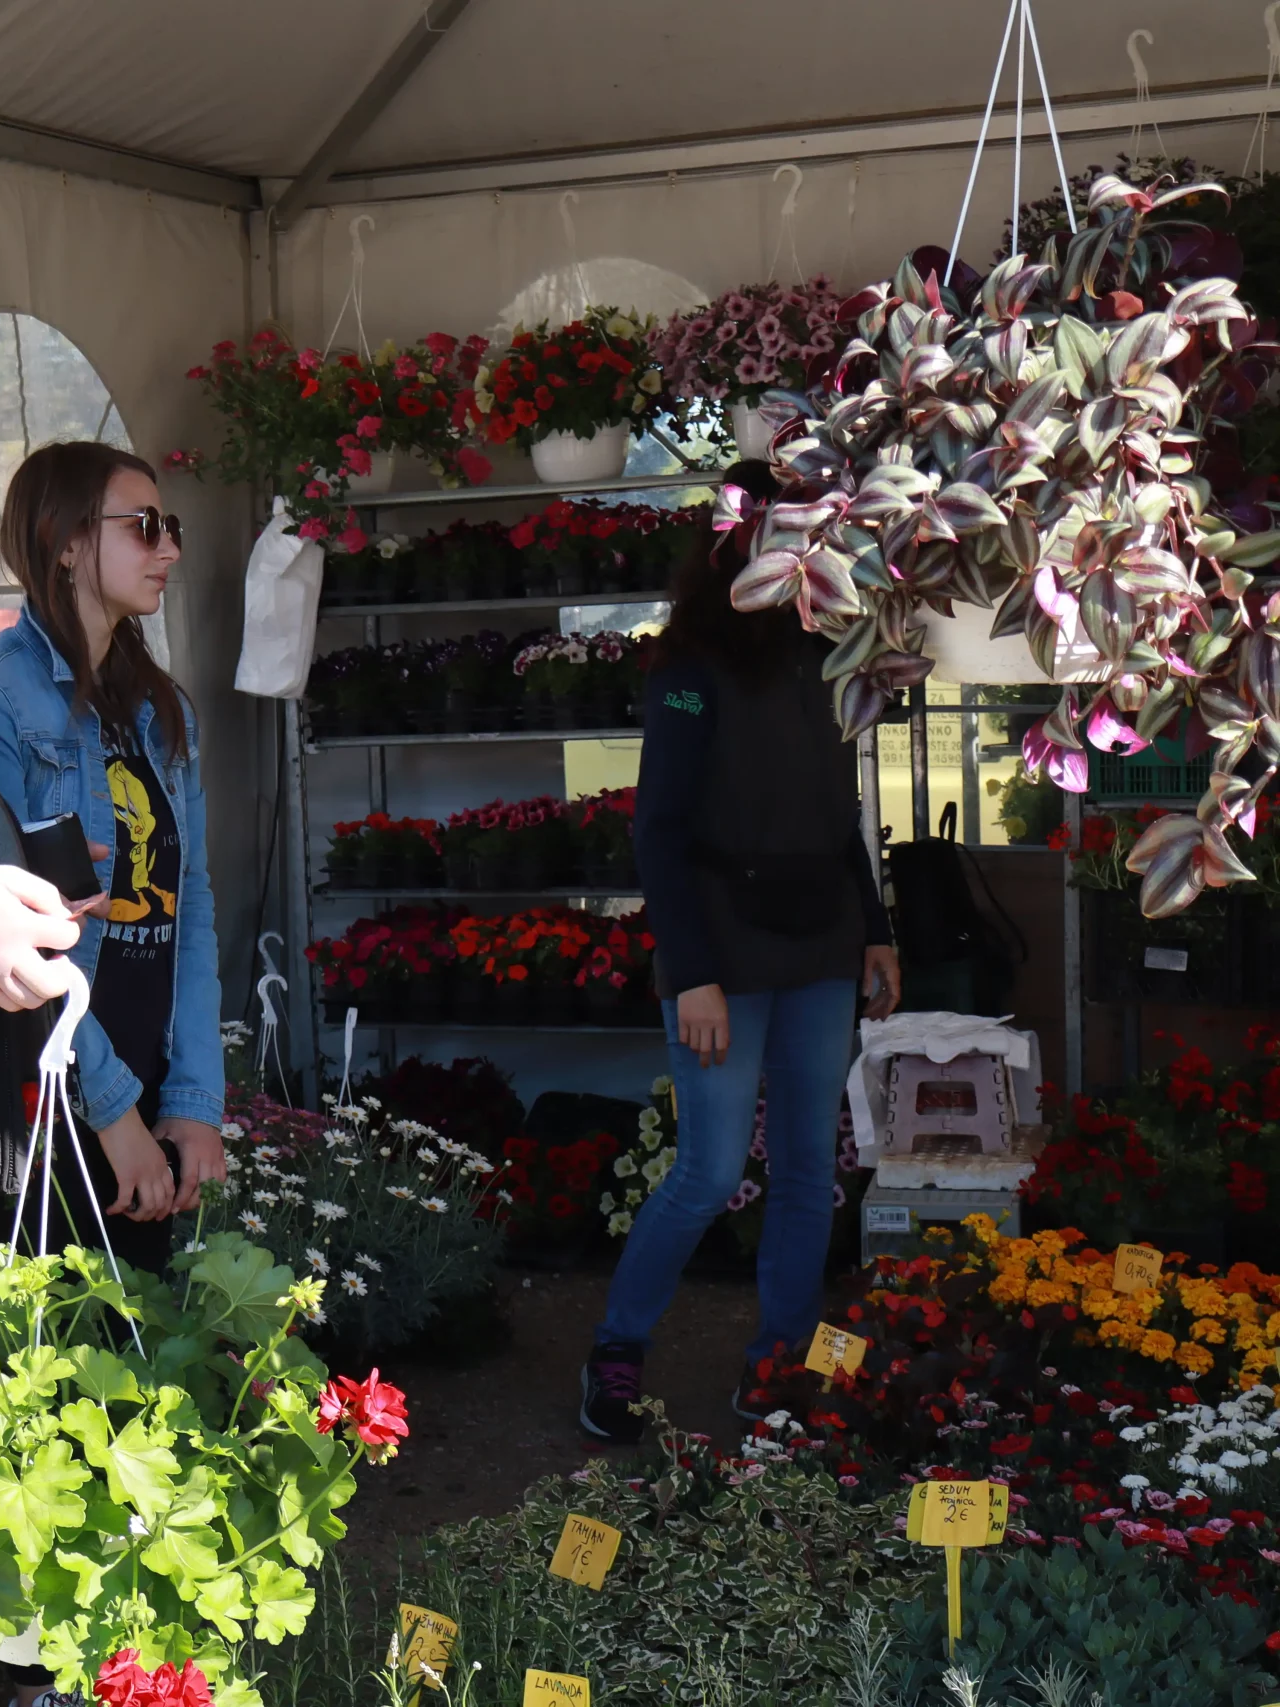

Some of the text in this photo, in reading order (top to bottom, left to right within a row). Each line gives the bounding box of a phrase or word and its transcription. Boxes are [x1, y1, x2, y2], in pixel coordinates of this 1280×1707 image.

[664, 692, 703, 715] Slavol
[938, 1484, 971, 1495] SEDUM
[571, 1519, 606, 1546] TAMJAN
